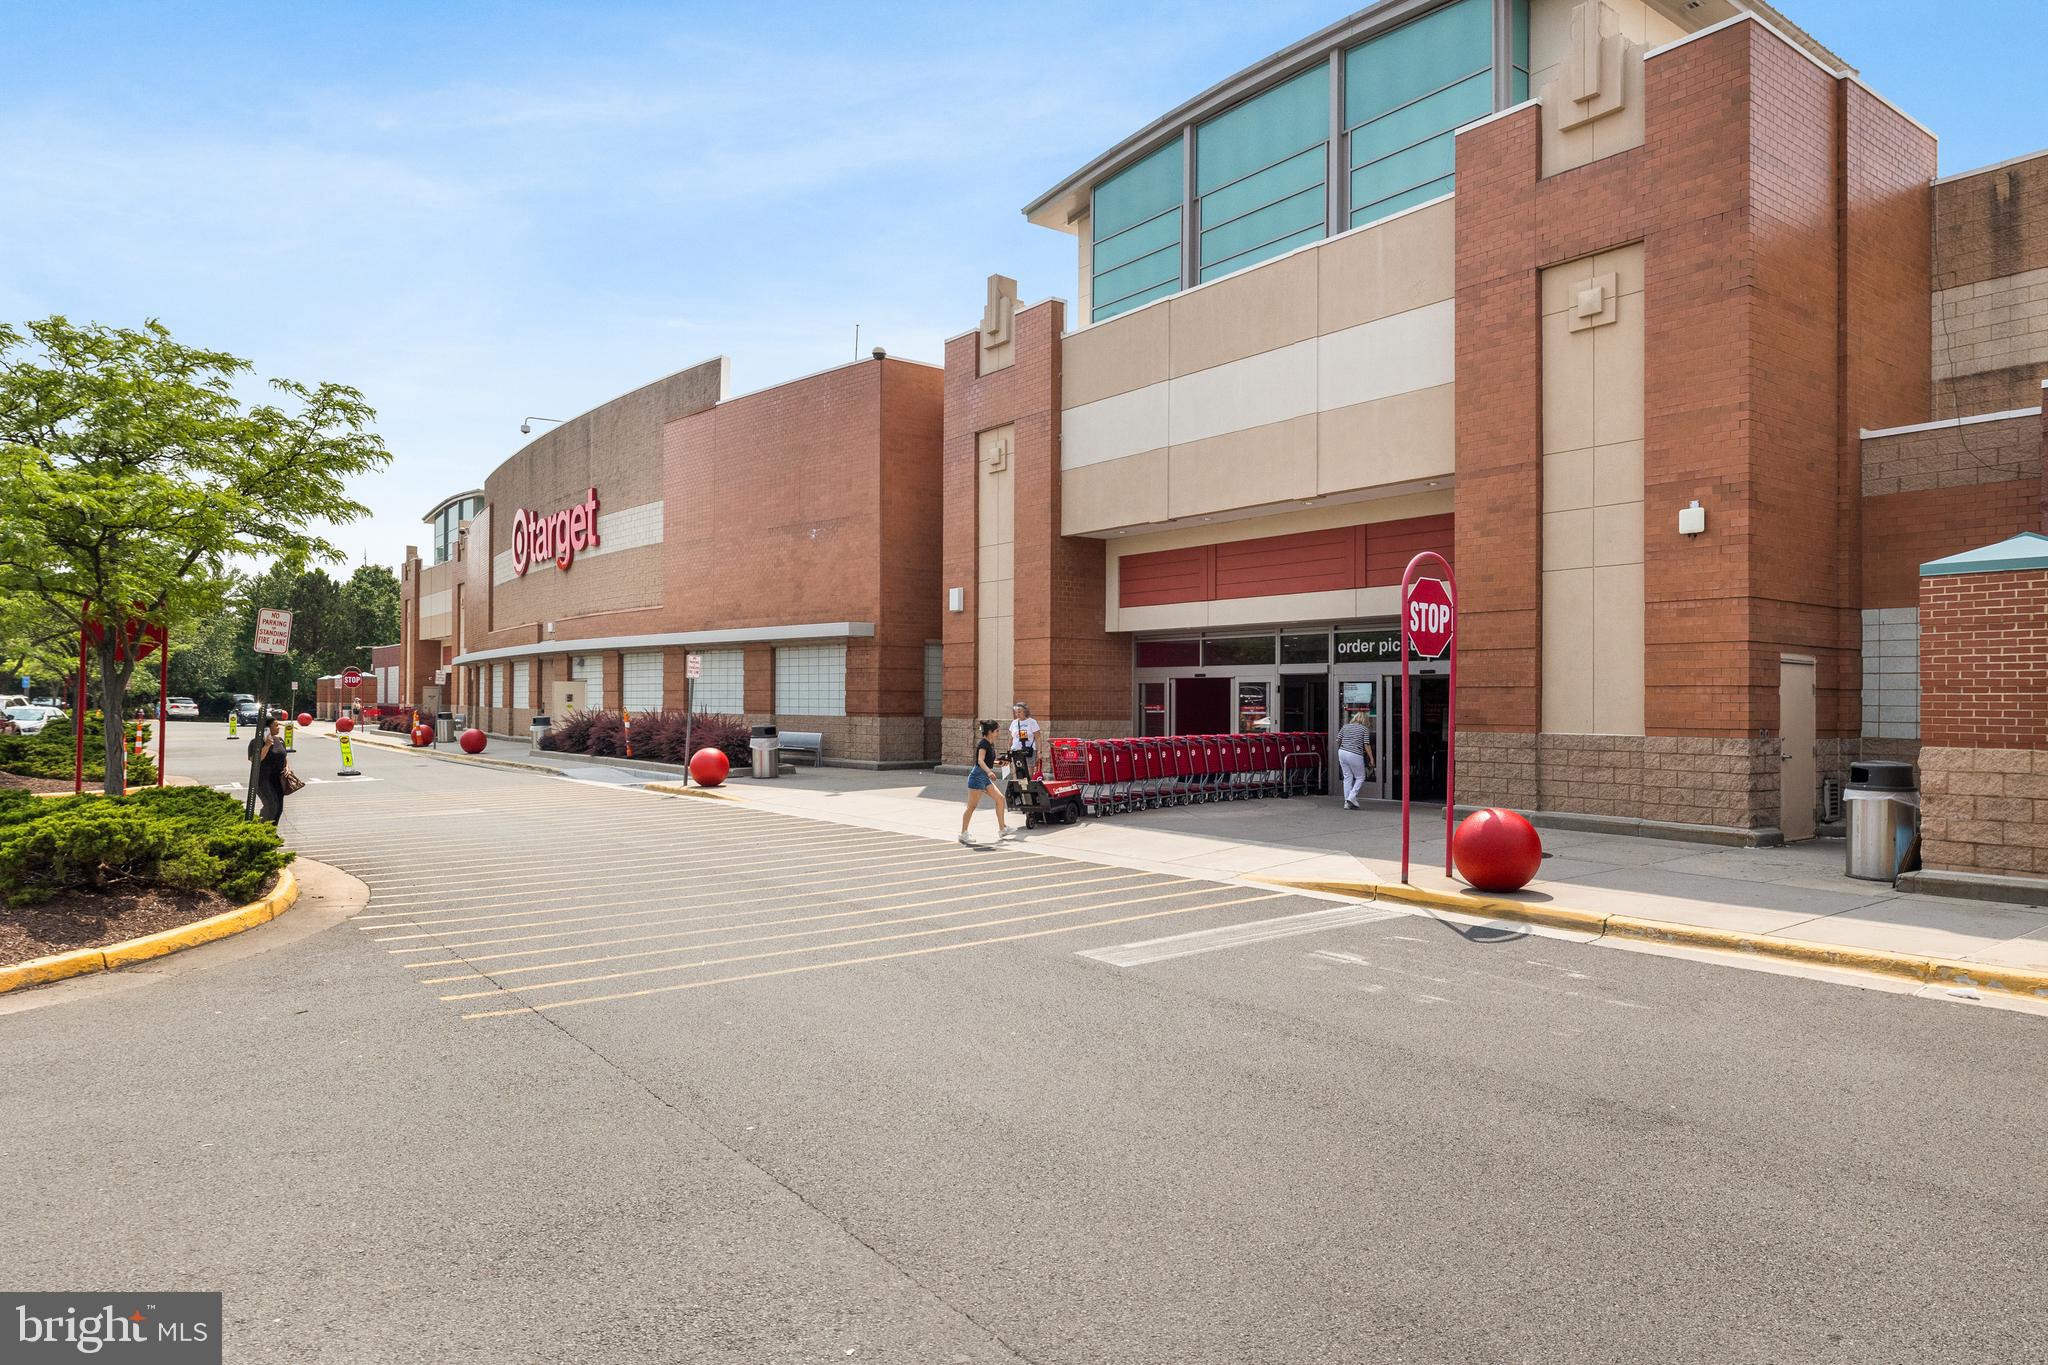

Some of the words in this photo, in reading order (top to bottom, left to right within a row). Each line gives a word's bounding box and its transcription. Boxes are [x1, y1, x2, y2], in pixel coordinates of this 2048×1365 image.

[528, 487, 601, 571] target
[1409, 600, 1450, 634] STOP
[262, 619, 287, 627] PARKING
[259, 629, 287, 638] STANDING
[272, 638, 286, 646] LANE
[1337, 638, 1376, 654] order
[344, 676, 361, 684] STOP
